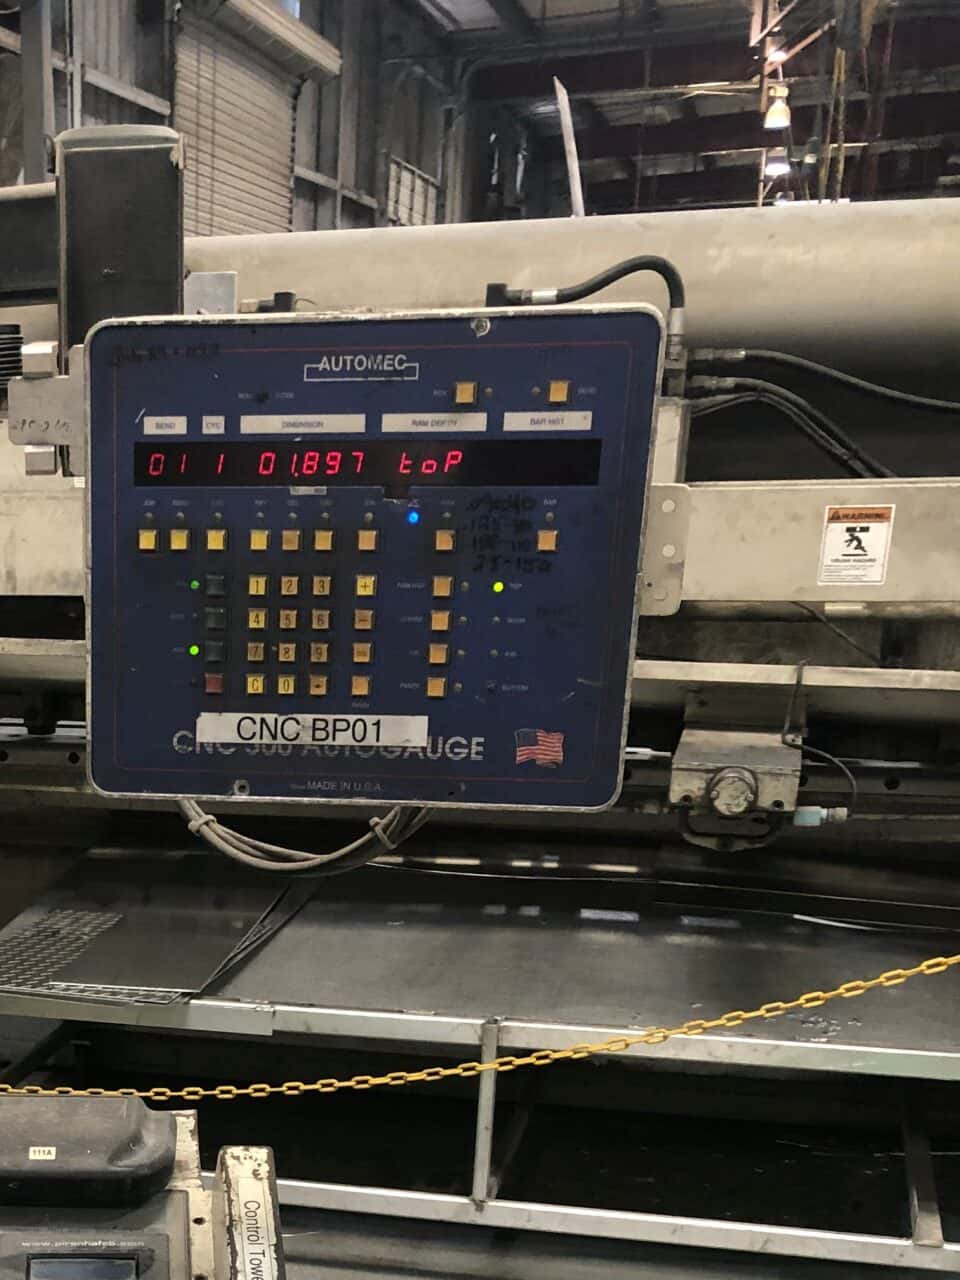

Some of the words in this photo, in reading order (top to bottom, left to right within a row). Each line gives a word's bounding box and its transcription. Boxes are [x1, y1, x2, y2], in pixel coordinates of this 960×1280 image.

[319, 354, 407, 371] AUTOMEC
[258, 451, 365, 477] 01.897
[286, 579, 293, 593] 2
[318, 579, 325, 593] 3
[253, 612, 260, 625] 4
[284, 613, 291, 626] 5
[317, 613, 324, 626] 6
[252, 646, 259, 659] 7
[283, 646, 290, 658] 8
[316, 646, 323, 659] 9
[236, 716, 301, 742] CNC
[312, 718, 382, 743] BP01
[32, 1149, 53, 1157] 111A
[244, 1200, 261, 1246] Control
